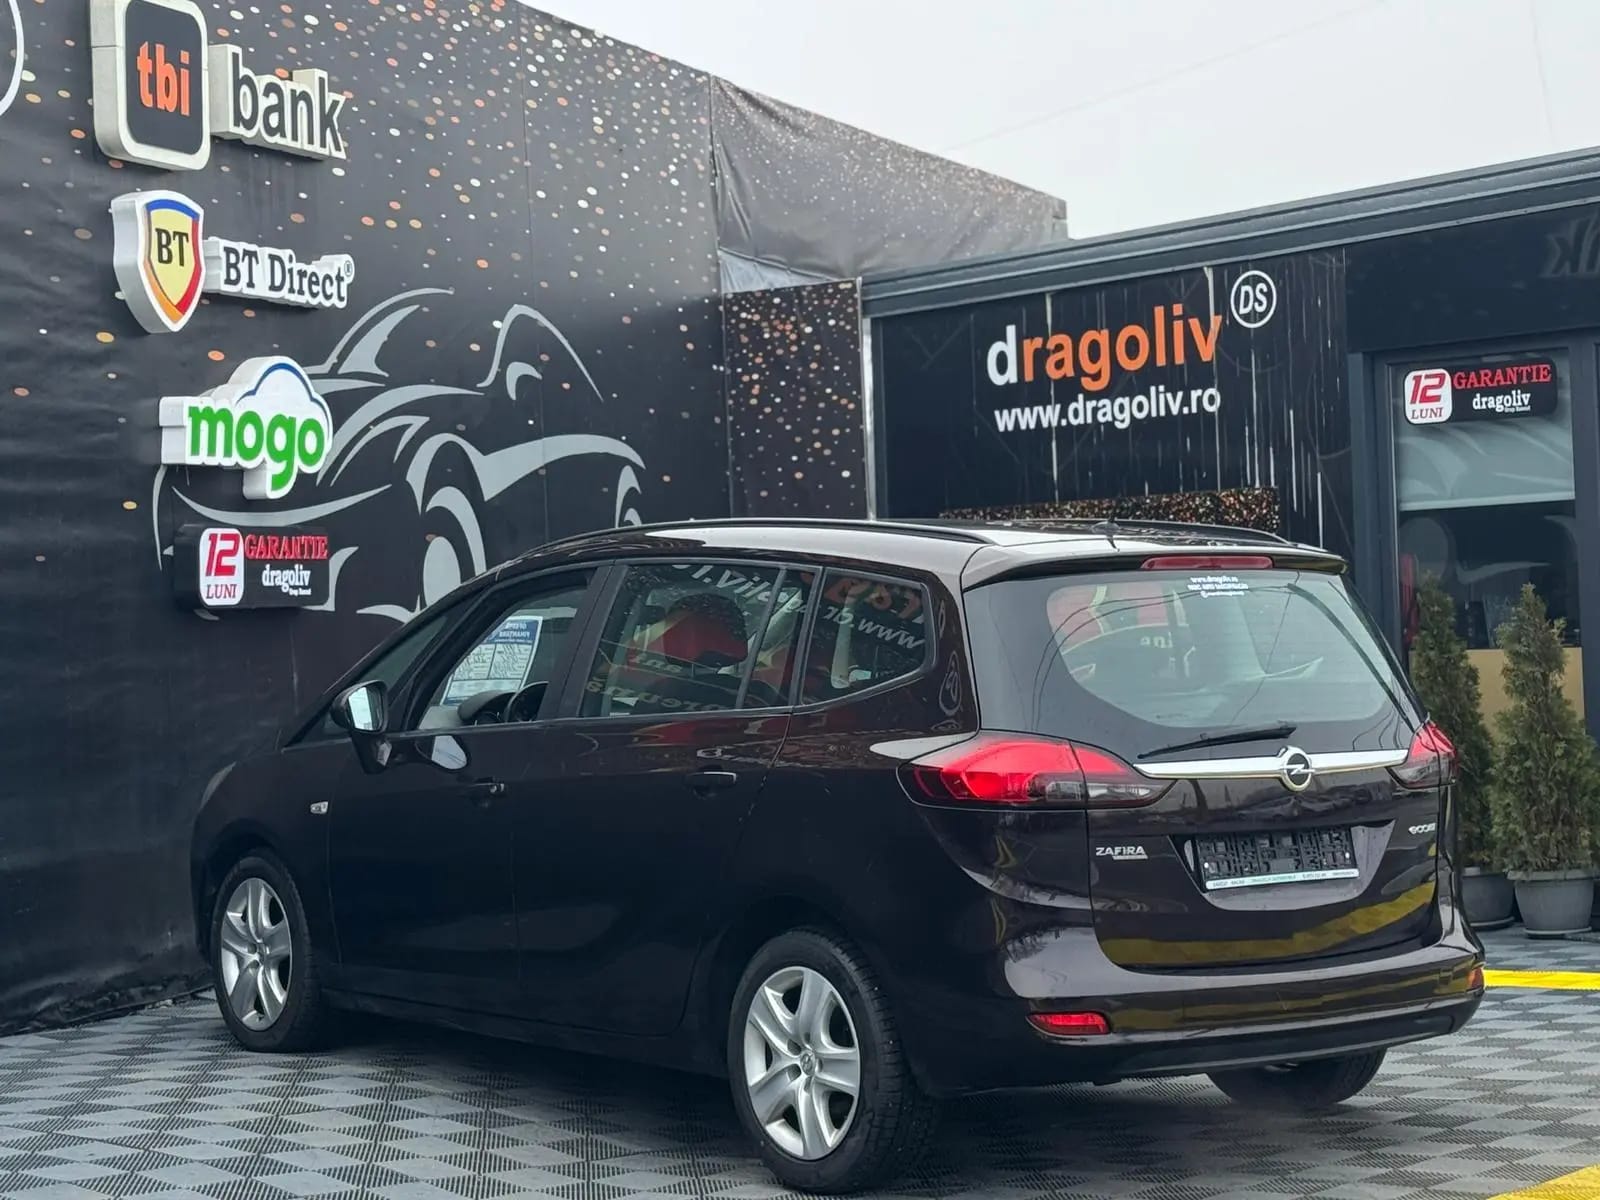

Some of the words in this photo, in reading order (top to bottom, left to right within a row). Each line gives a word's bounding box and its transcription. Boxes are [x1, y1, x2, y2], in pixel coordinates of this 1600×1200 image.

[137, 41, 190, 116] tbi
[232, 52, 344, 153] bank
[155, 228, 189, 267] BT
[223, 246, 260, 289] BT
[1239, 282, 1268, 315] DS
[986, 303, 1223, 391] dragoliv
[1410, 372, 1447, 405] 12
[1452, 364, 1552, 390] GARANTIE
[994, 384, 1222, 432] www.dragoliv.ro
[1411, 407, 1443, 420] LUNI
[1472, 390, 1531, 413] dragoliv
[188, 405, 325, 492] mogo
[205, 533, 241, 577] 12
[245, 534, 329, 560] GARANTIE
[205, 584, 238, 599] LUNI
[262, 564, 311, 593] dragoliv
[1095, 845, 1146, 856] ZAFIRA
